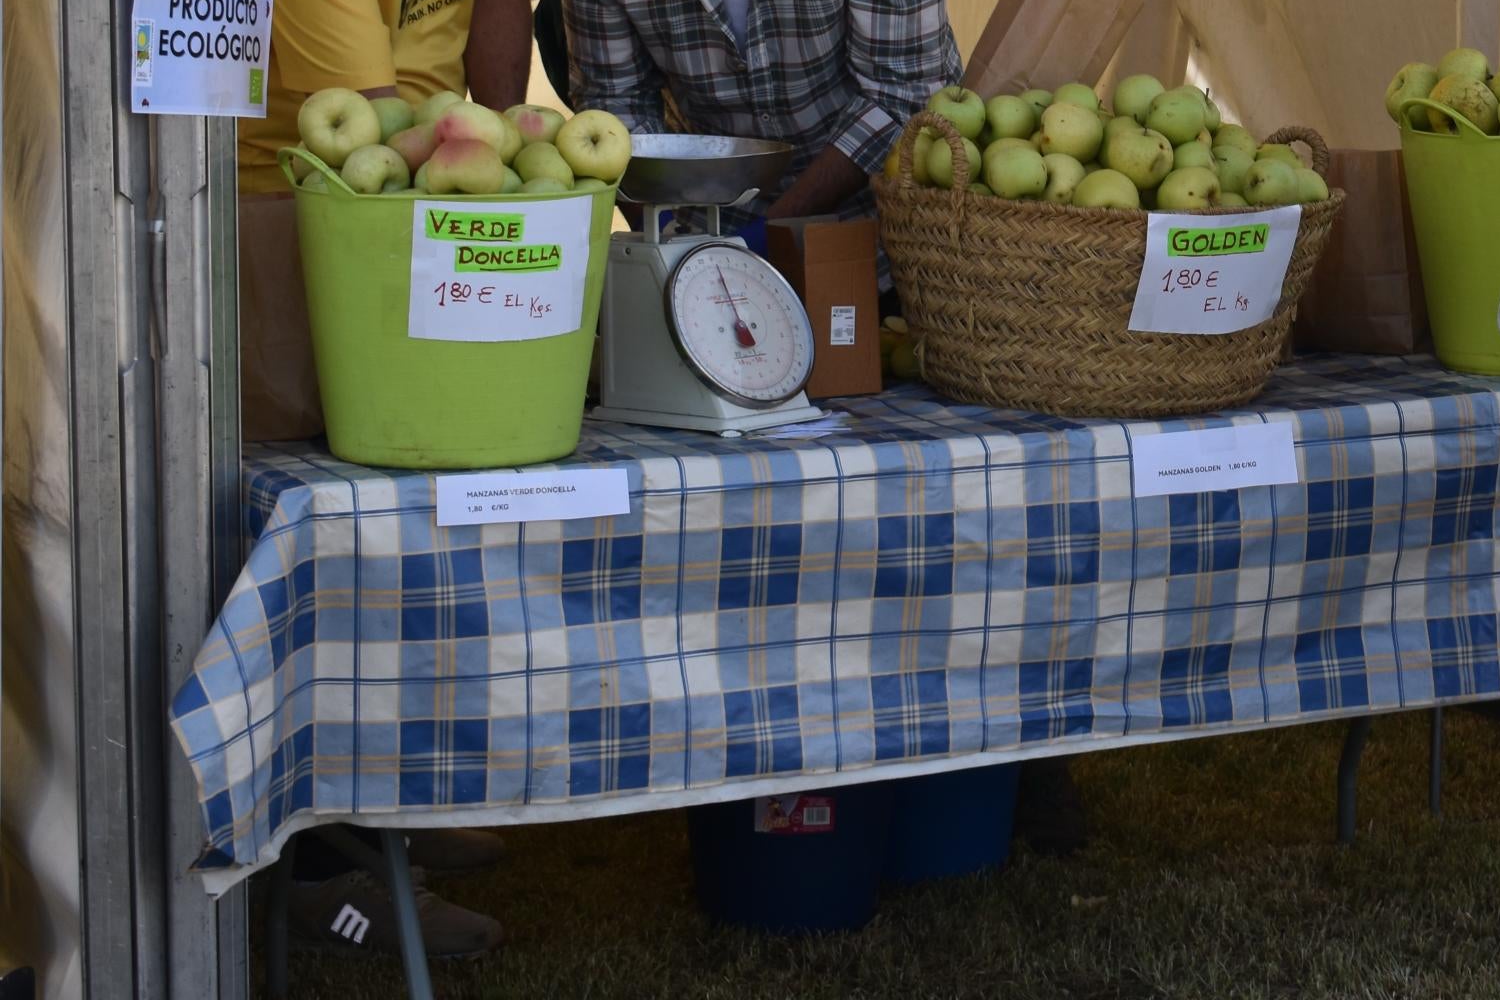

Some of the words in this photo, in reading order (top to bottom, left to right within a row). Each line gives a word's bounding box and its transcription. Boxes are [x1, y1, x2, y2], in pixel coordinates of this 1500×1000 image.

[427, 0, 443, 14] NO
[159, 25, 261, 63] ECOLÓGICO
[429, 210, 521, 238] VERDE
[1172, 228, 1266, 253] GOLDEN
[458, 245, 560, 265] DONCELLA
[1205, 270, 1220, 288] €
[477, 286, 496, 304] €
[504, 294, 524, 307] EL
[1203, 296, 1227, 312] EL
[1158, 466, 1194, 478] MANZANAS
[1194, 464, 1221, 474] GOLDEN
[466, 488, 509, 499] MANZANAS
[509, 487, 535, 496] VERDE
[535, 485, 576, 495] DONCELLA
[491, 503, 509, 512] €/KG
